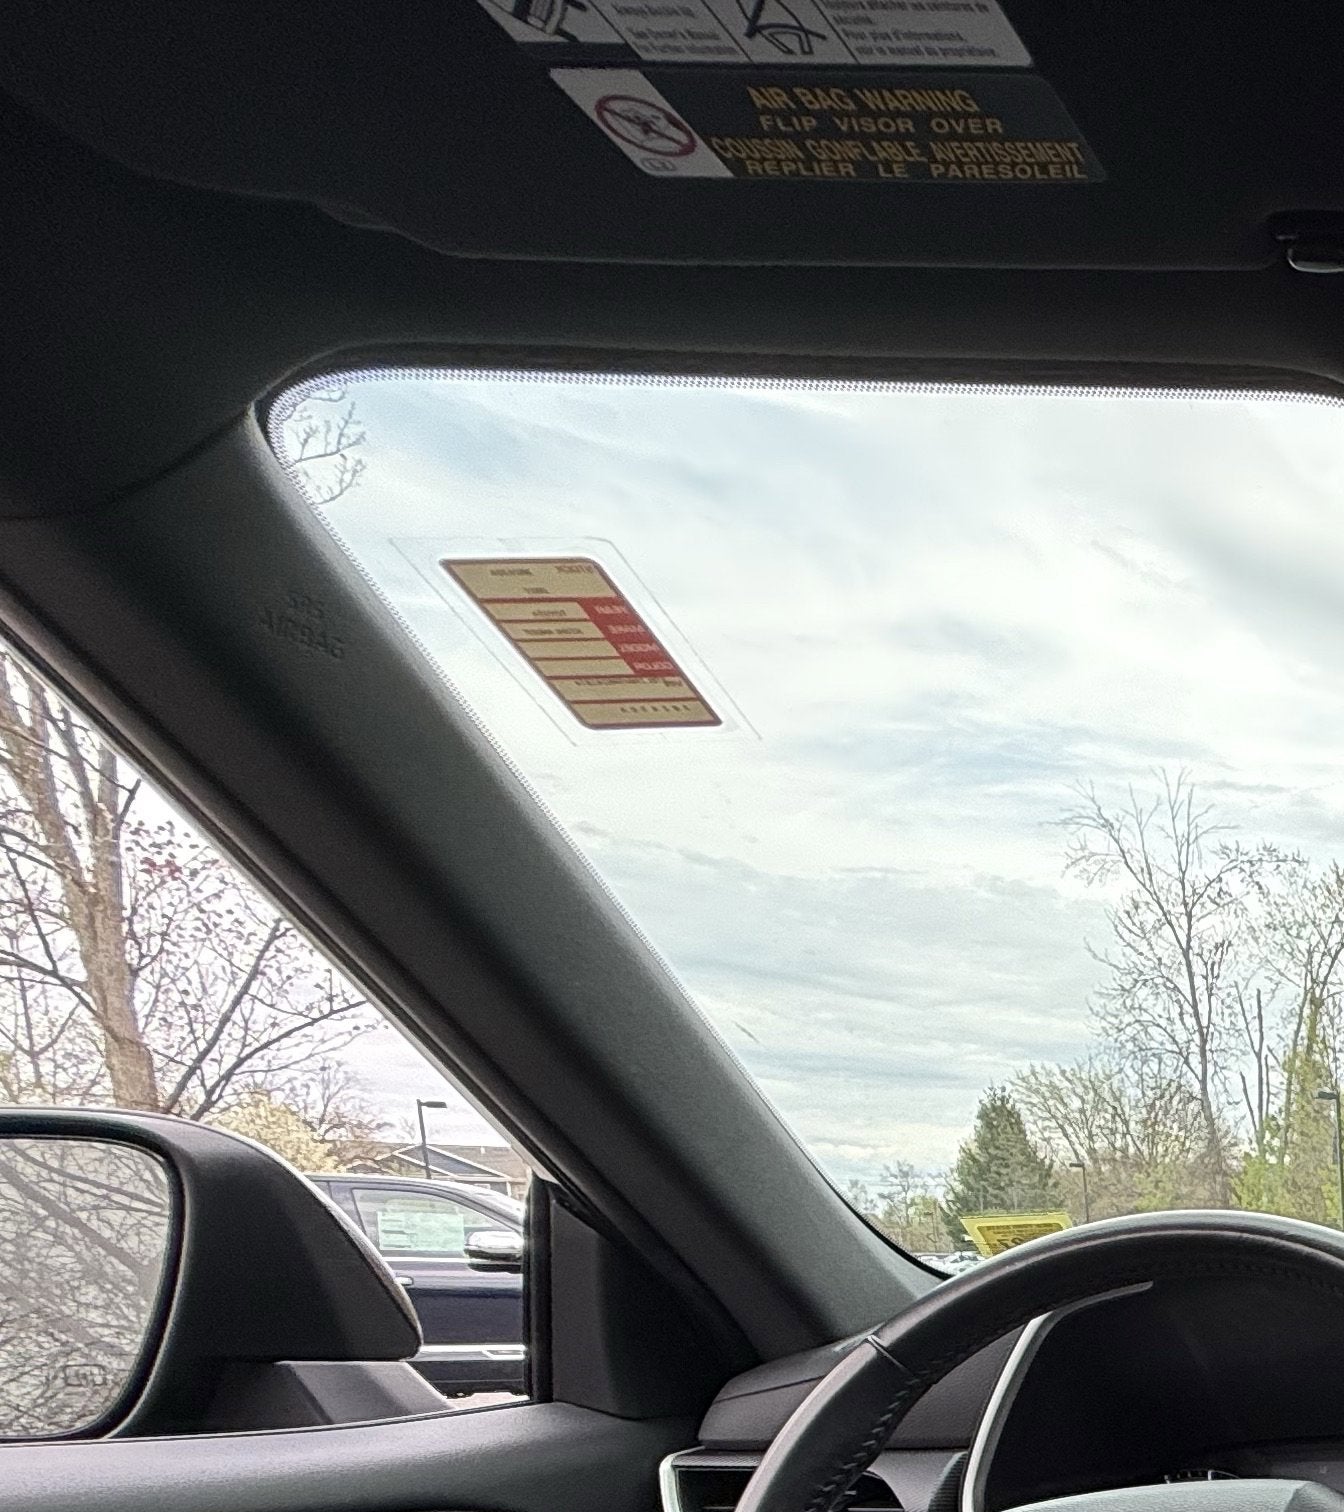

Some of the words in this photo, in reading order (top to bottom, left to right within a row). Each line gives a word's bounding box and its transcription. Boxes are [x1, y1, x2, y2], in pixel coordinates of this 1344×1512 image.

[747, 86, 797, 110] AIR
[793, 86, 856, 112] BAG
[853, 88, 981, 113] WARNING
[759, 115, 817, 132] FLIP
[834, 116, 915, 133] VISOR
[930, 117, 1003, 134] OVER
[711, 136, 805, 159] COUSSIN
[929, 141, 1084, 164] AVERTISSEMENT
[746, 159, 857, 176] REPLIER
[877, 161, 911, 178] LE
[930, 162, 1088, 179] PARESOLEIL
